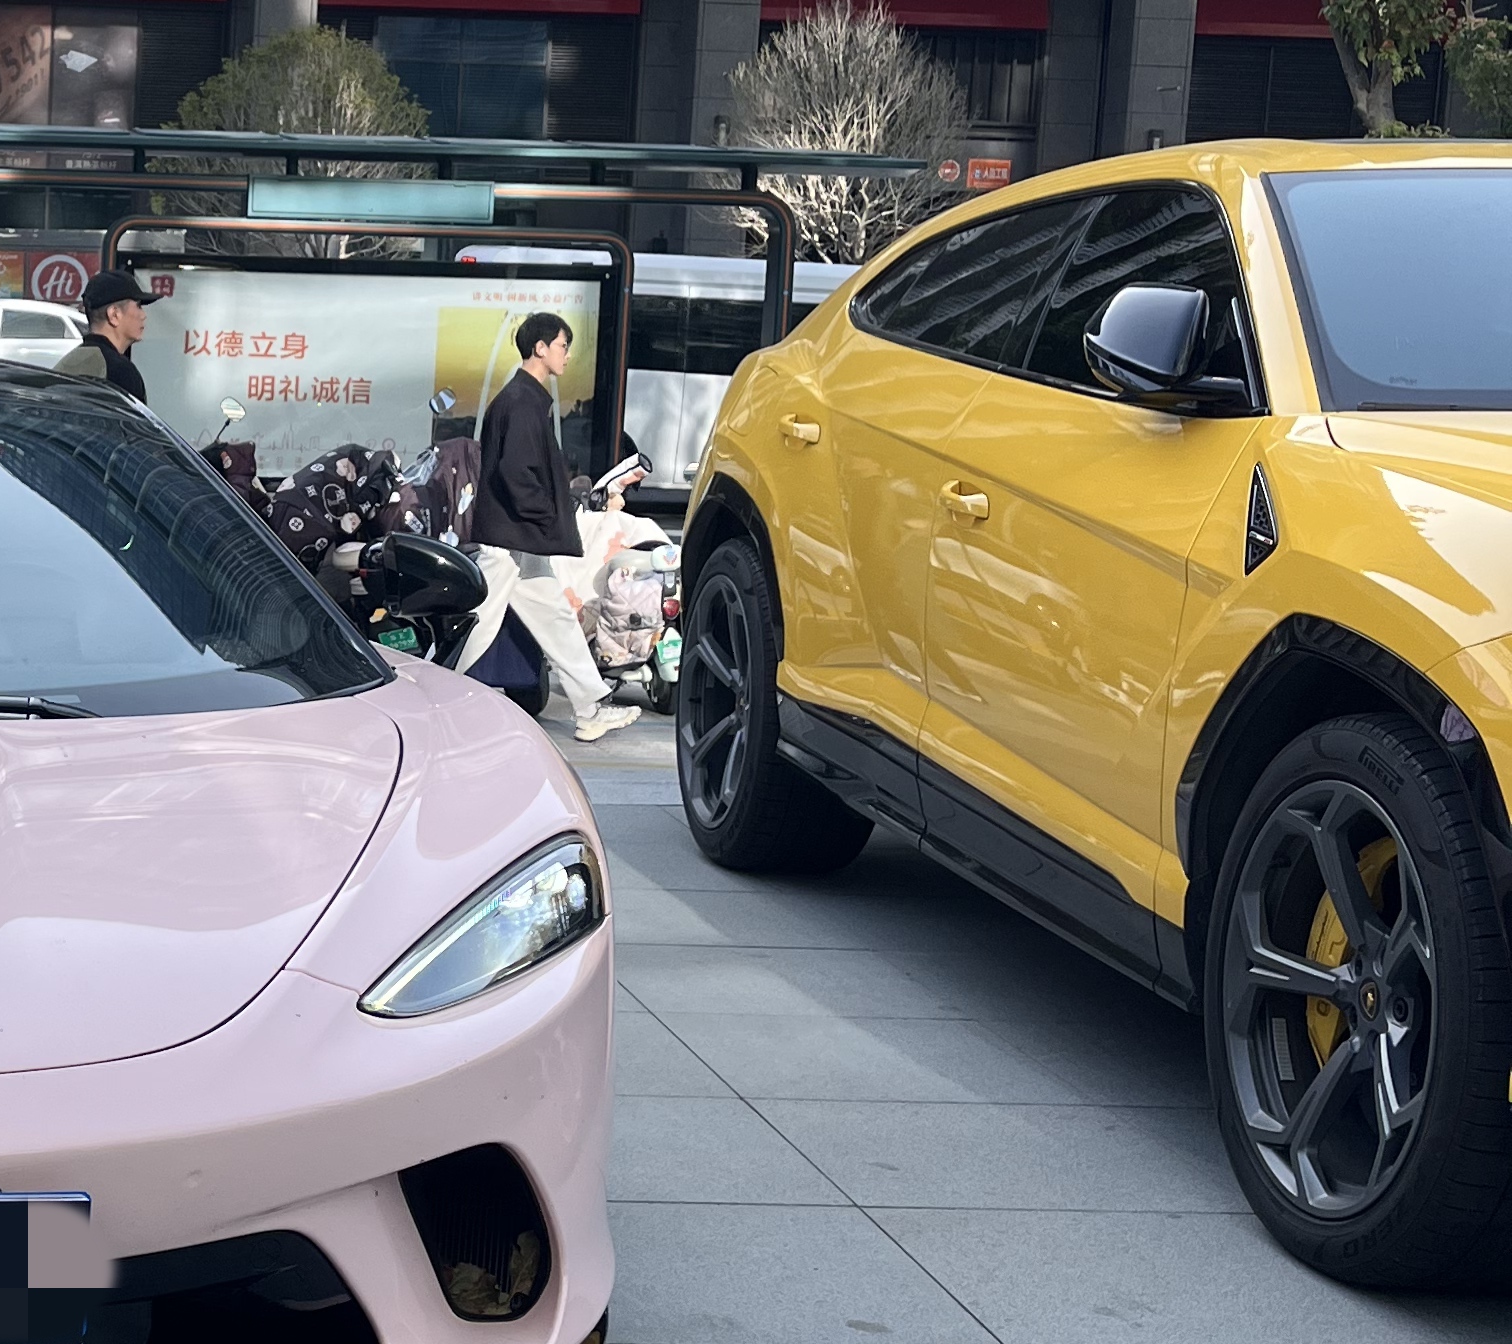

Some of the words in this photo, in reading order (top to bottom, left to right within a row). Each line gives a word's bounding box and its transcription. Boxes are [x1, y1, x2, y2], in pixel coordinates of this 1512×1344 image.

[43, 265, 76, 299] Hi
[183, 330, 309, 359] 以德立身
[247, 375, 372, 405] 明礼诚信
